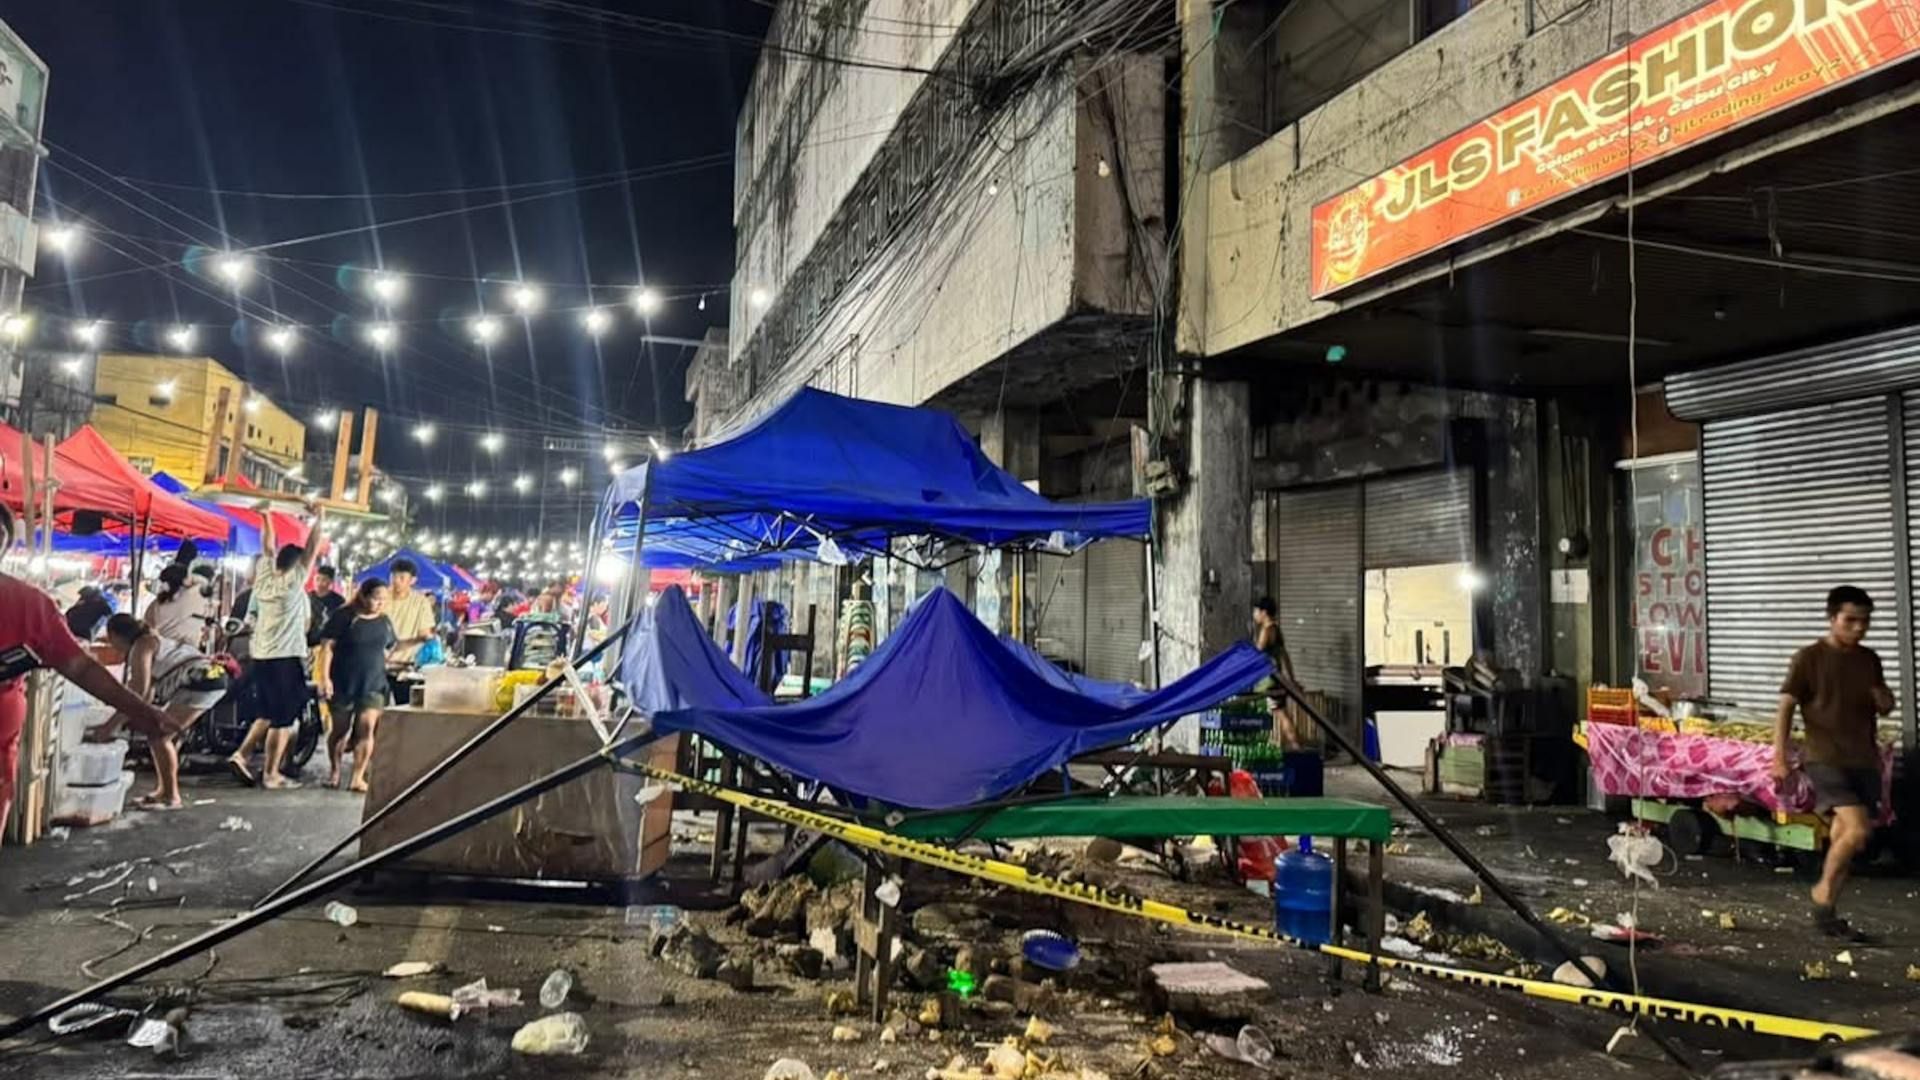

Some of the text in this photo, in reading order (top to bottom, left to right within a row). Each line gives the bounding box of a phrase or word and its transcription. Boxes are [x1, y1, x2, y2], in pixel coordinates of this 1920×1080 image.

[1668, 87, 1724, 117] Cebu
[1727, 60, 1779, 91] City
[1383, 140, 1490, 218] JLS
